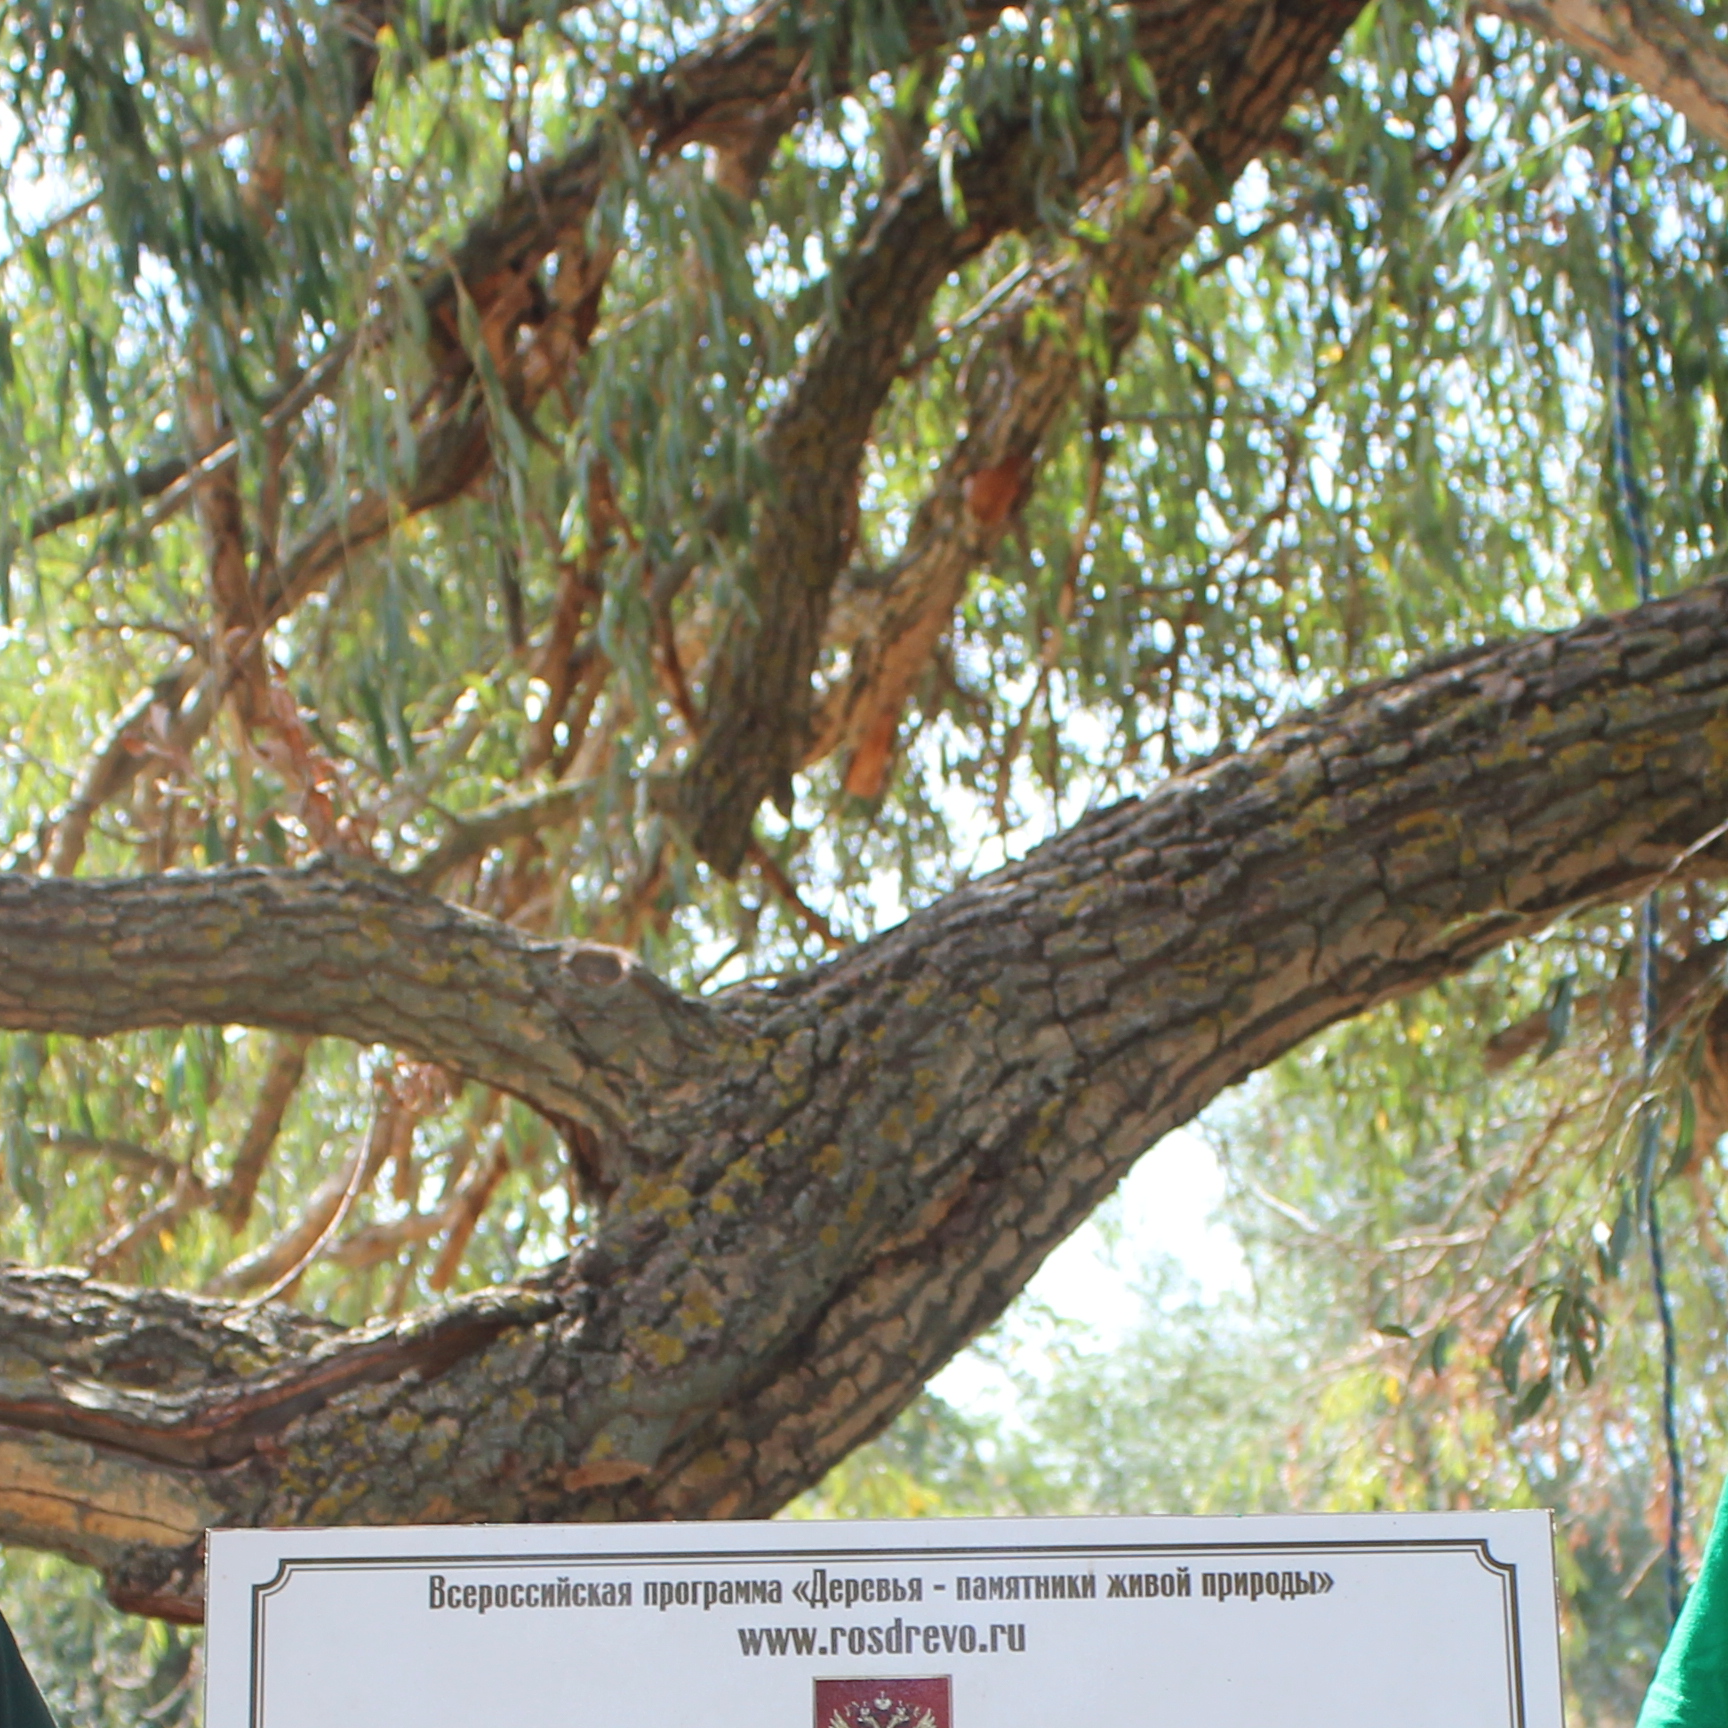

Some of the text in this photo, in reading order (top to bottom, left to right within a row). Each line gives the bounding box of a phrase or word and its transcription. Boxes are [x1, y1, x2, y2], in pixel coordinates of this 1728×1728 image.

[428, 1574, 633, 1615] Всероссийская
[643, 1579, 783, 1612] программа
[791, 1568, 923, 1610] «Деревья
[956, 1572, 1097, 1601] памятники
[1106, 1566, 1192, 1599] живой
[1201, 1570, 1335, 1603] природы»
[737, 1617, 1026, 1657] www.rosdrevo.ru
